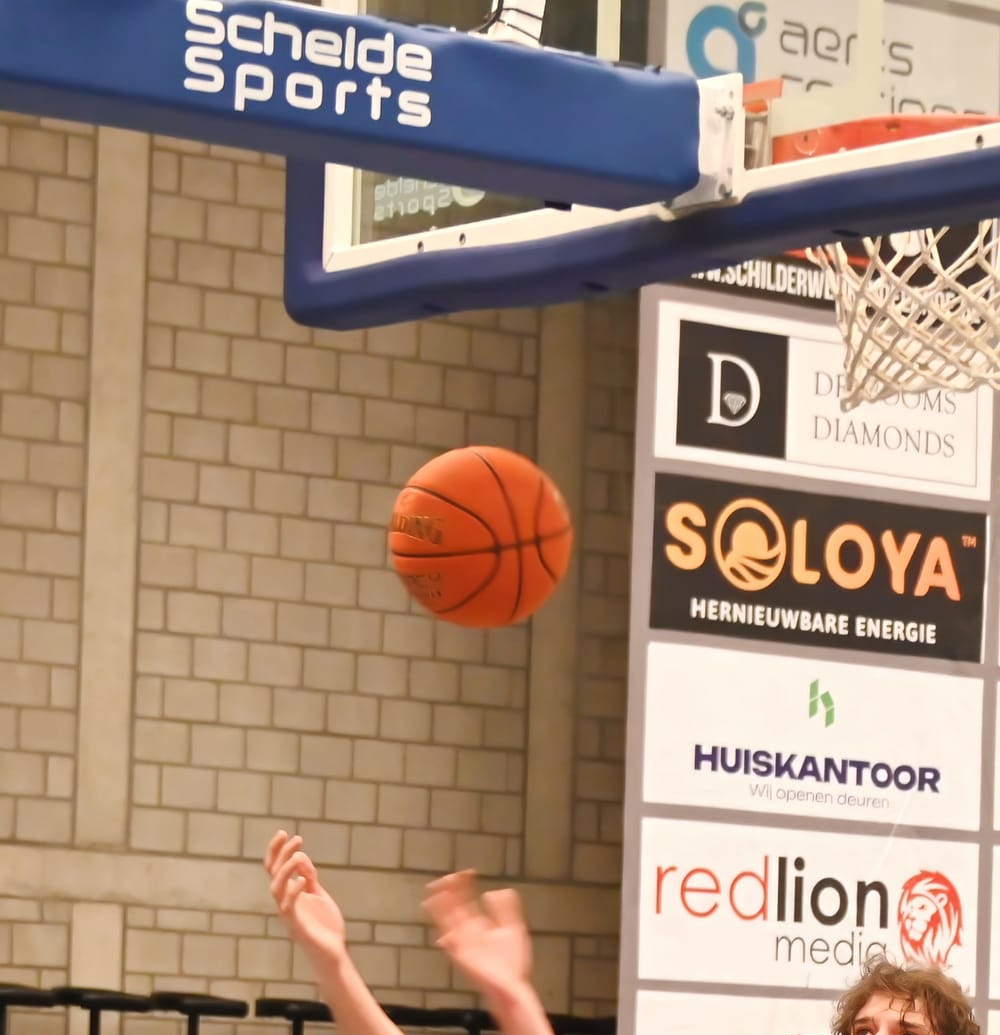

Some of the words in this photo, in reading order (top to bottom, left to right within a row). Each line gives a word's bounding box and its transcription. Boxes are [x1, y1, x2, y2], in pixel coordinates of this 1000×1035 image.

[185, 0, 433, 82] Schelde
[779, 19, 914, 77] aers
[184, 46, 432, 127] Sports
[812, 415, 956, 458] DIAMONDS
[664, 497, 961, 602] SOLOYA
[690, 597, 849, 636] HERNIEUWBARE
[855, 615, 937, 644] ENERGIE
[693, 744, 942, 793] HUISKANTOOR
[748, 783, 772, 801] Wij
[776, 788, 834, 805] openen
[837, 793, 890, 809] deuren
